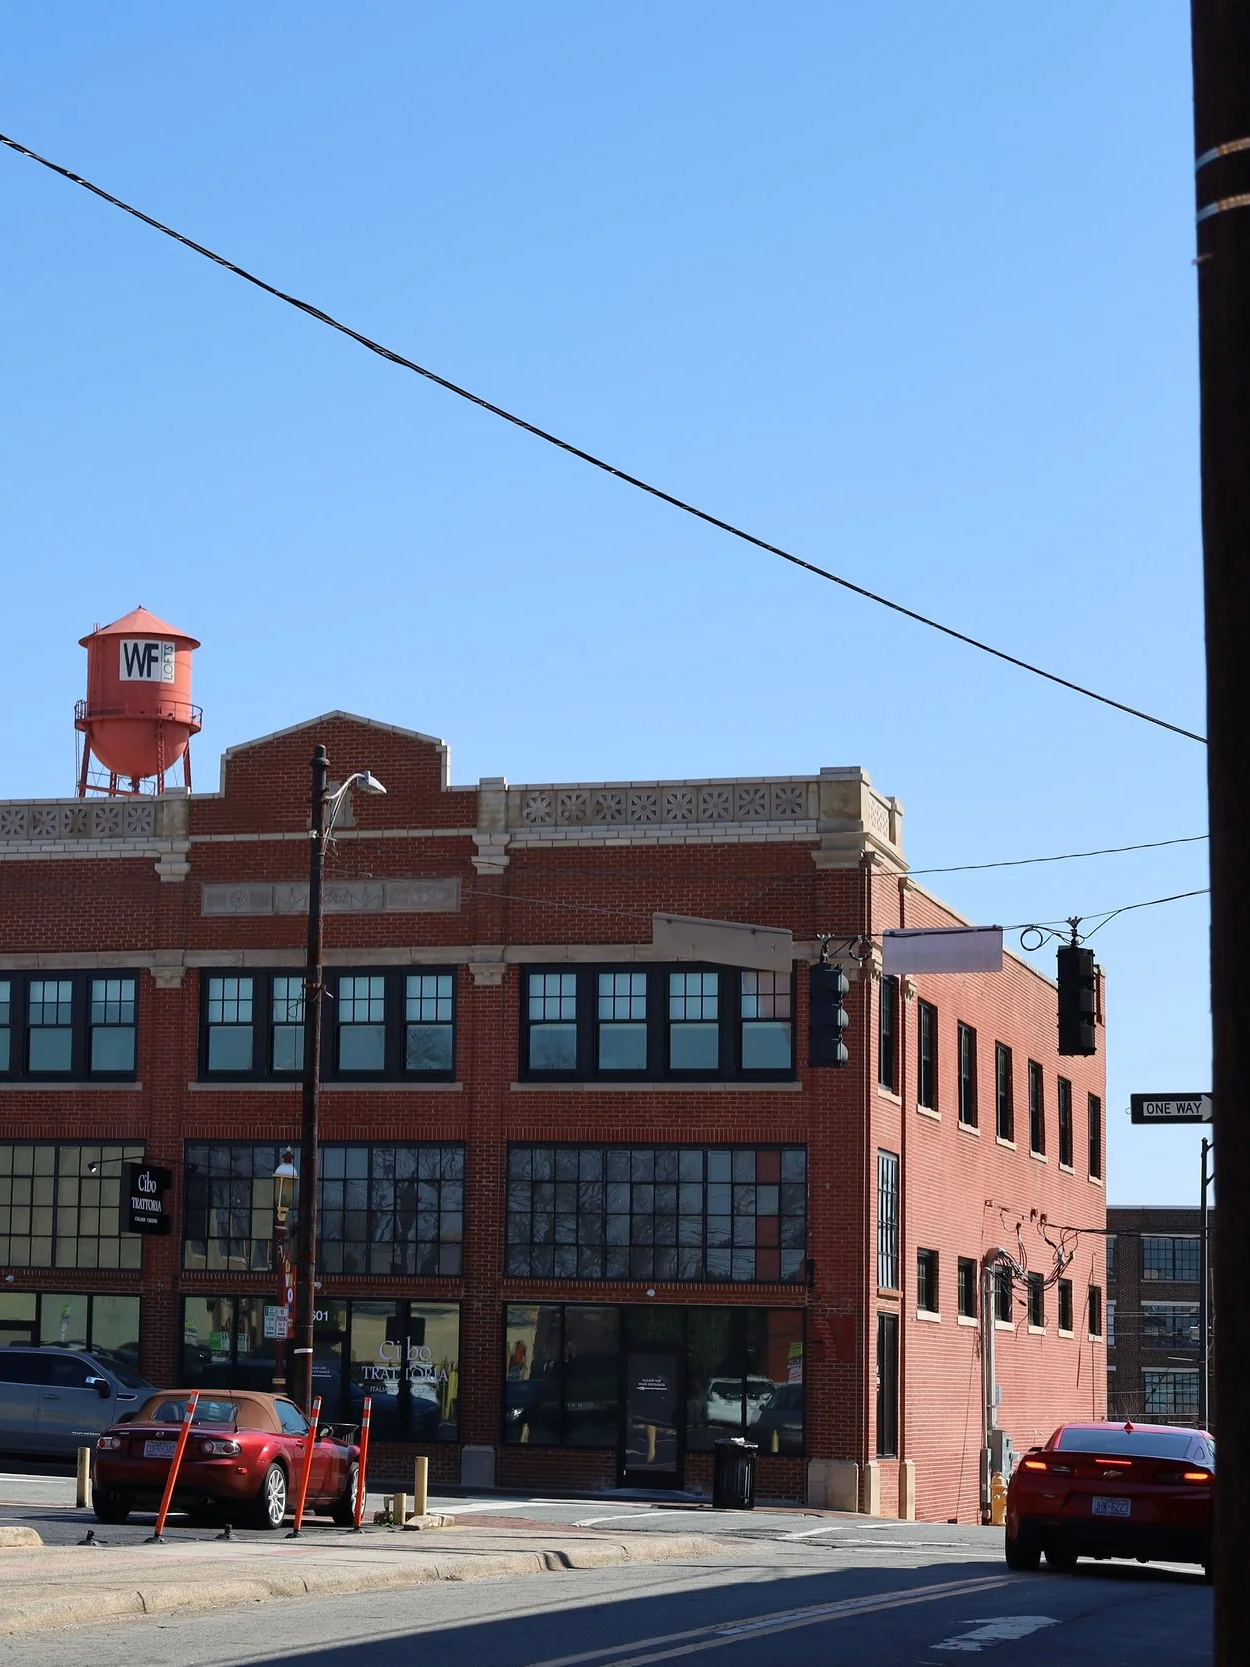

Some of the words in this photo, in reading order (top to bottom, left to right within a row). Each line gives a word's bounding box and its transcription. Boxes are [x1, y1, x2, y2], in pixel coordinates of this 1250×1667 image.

[123, 642, 159, 678] WF
[163, 644, 174, 680] LOFTS
[1146, 1102, 1172, 1115] ONE
[1175, 1102, 1202, 1114] WAY
[138, 1170, 157, 1193] Cibo
[131, 1196, 162, 1212] TRATTORIA
[378, 1336, 434, 1361] Cibo
[361, 1365, 449, 1381] TRATTORIA
